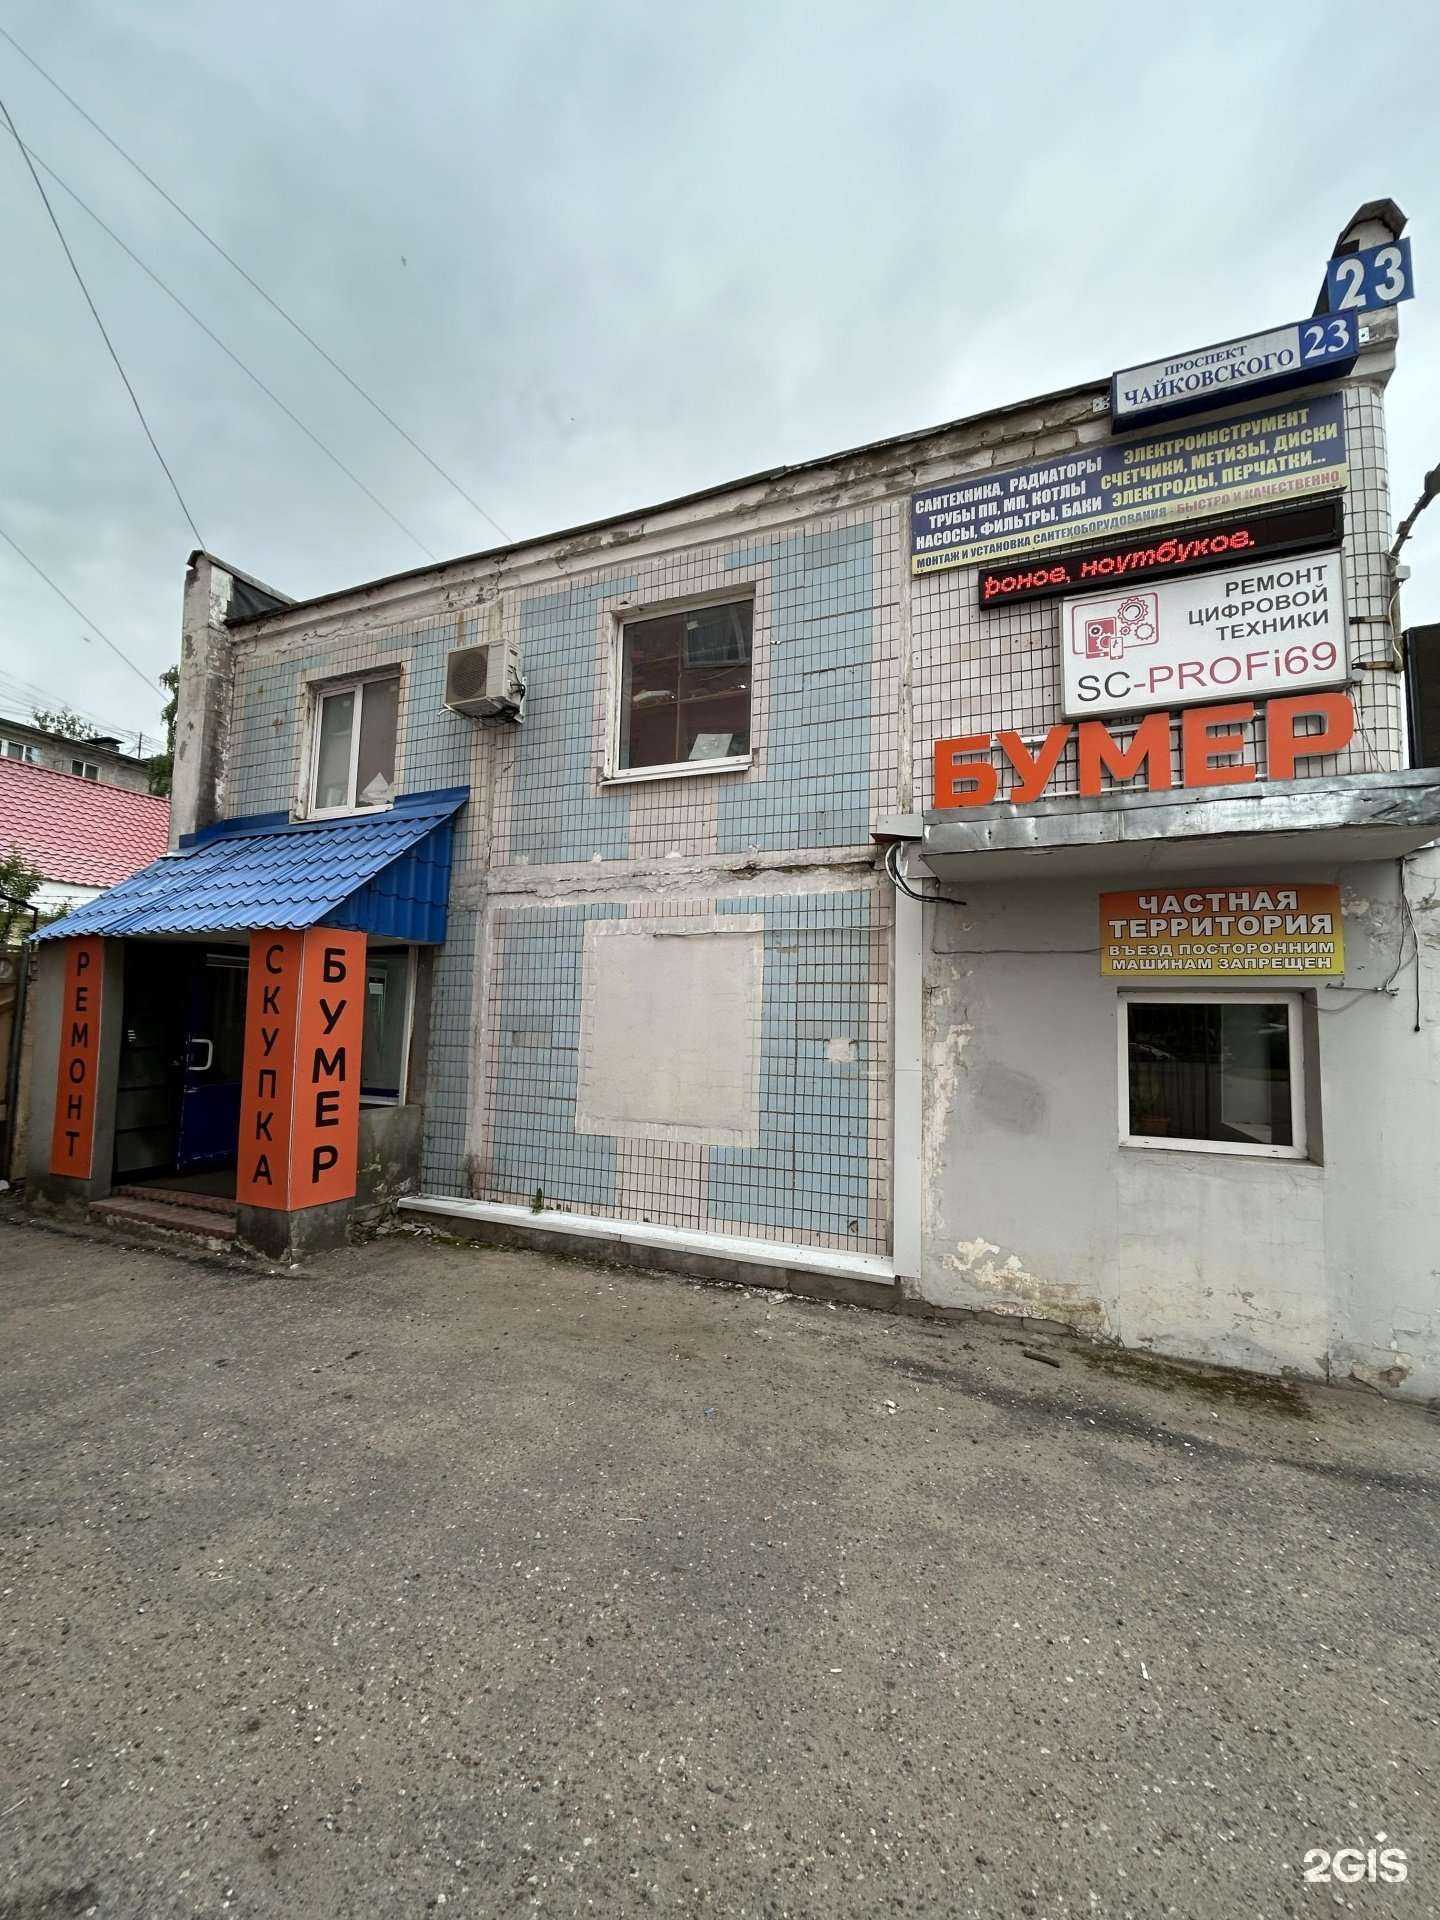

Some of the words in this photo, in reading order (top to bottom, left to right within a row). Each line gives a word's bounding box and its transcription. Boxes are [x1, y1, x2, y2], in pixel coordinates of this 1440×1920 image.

[1335, 246, 1405, 310] 23
[1163, 345, 1247, 377] ПРОСПЕКТ
[1304, 319, 1350, 359] 23
[1123, 348, 1294, 406] ЧАЙКОВСКОГО
[1101, 459, 1188, 490] СЧЕТЧИКИ,
[1191, 440, 1271, 471] МЕТИЗЫ,
[1274, 423, 1338, 454] ДИСКИ
[1124, 408, 1310, 465] ЭЛЕКТРОИНСТРУМЕНТ
[915, 482, 1004, 514] САНТЕХНИКА,
[1009, 456, 1102, 493] РАДИАТОРЫ
[929, 508, 976, 529] ТРУБЫ
[978, 502, 1001, 519] ПП,
[1003, 496, 1029, 513] МП,
[1031, 480, 1086, 506] КОТЛЫ
[1112, 471, 1218, 507] ЭЛЕКТРОДЫ,
[1222, 450, 1326, 484] ПЕРЧАТКИ...
[916, 552, 960, 569] МОНТАЖ
[962, 549, 969, 559] И
[970, 537, 1031, 557] УСТАНОВКА
[1033, 506, 1167, 545] САНТЕХОБОРУДОВАНИЯ
[1176, 494, 1231, 514] БЫСТРО
[1233, 490, 1242, 503] И
[1243, 470, 1340, 500] КАЧЕСТВЕННО
[916, 526, 978, 550] НАСОСЫ,
[980, 507, 1059, 536] ФИЛЬТРЫ,
[1062, 496, 1102, 518] БАКИ
[1080, 530, 1255, 578] ноутбуков.
[1225, 564, 1328, 598] РЕМОНТ
[1188, 585, 1328, 626] ЦИФРОВОЙ
[1216, 609, 1329, 641] ТЕХНИКИ
[1077, 641, 1338, 702] SC-PROFi69
[932, 692, 1354, 809] БУМЕР
[1108, 914, 1333, 939] ТЕРРИТОРИЯ
[1138, 890, 1298, 915] ЧАСТНАЯ
[1108, 943, 1174, 957] ВЪЕЗД
[1179, 941, 1334, 956] ПОСТОРОННИМ
[1111, 957, 1212, 970] МАШИНАМ
[1217, 957, 1332, 972] ЗАПРЕЩЕН
[65, 951, 90, 1158] РЕМОНТ
[251, 944, 285, 1187] СКУПКА
[311, 947, 347, 1184] БУМЕР
